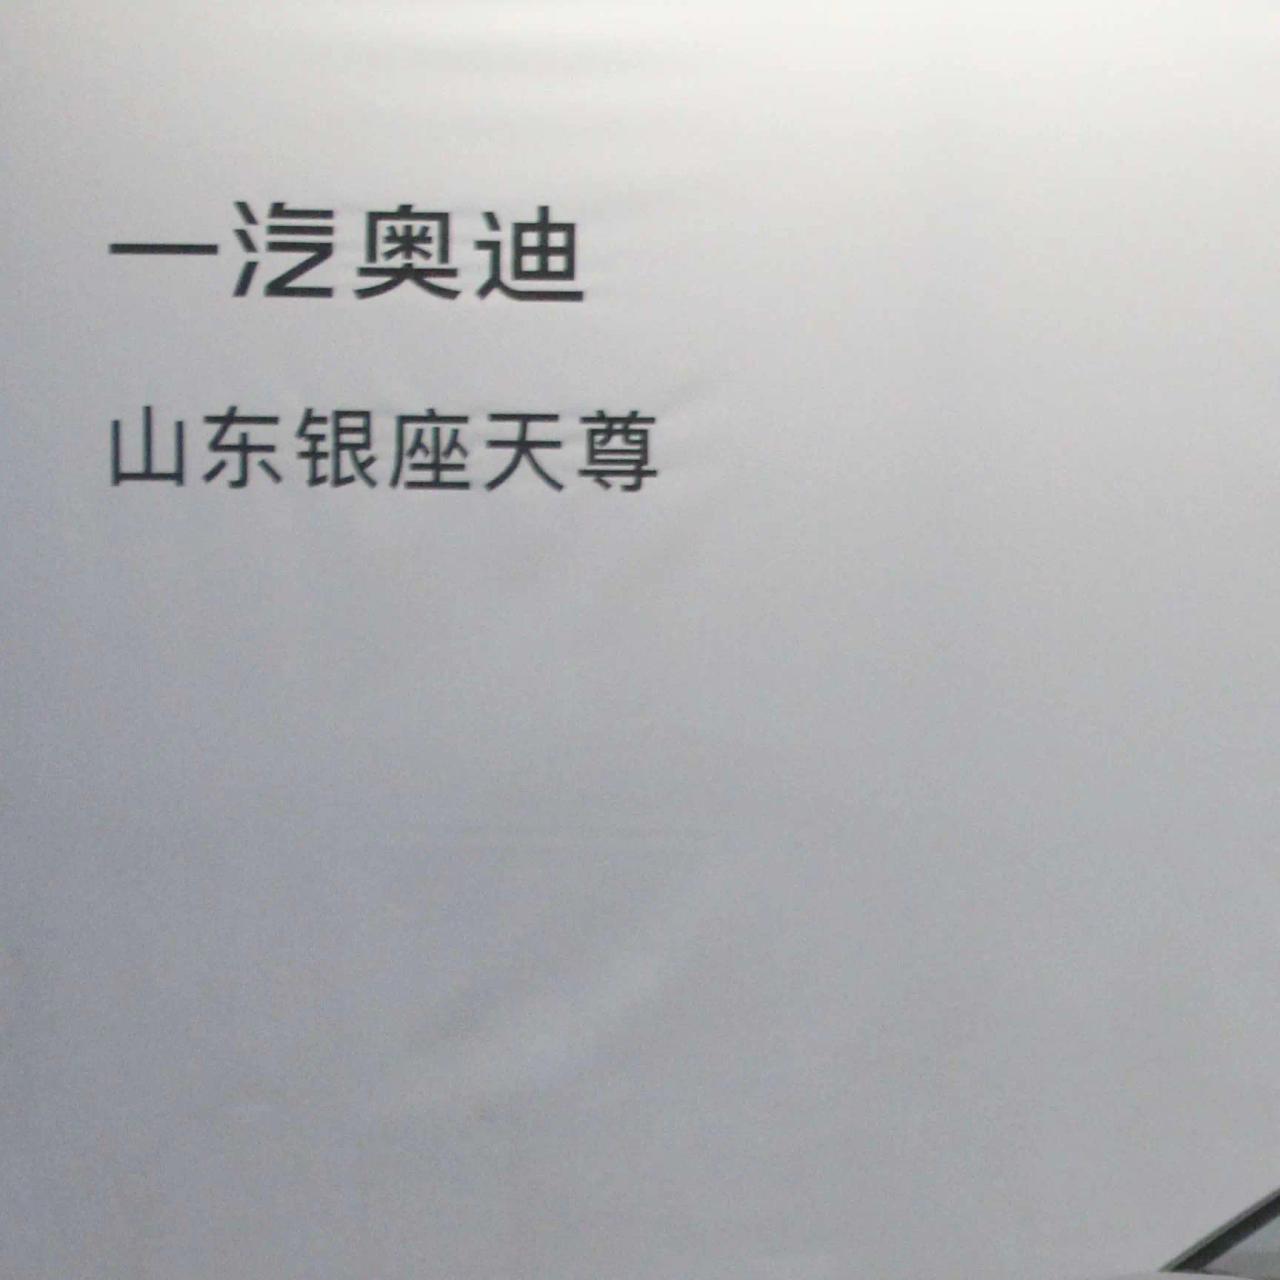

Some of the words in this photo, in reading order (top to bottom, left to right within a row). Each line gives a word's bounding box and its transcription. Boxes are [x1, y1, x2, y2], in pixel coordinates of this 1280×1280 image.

[108, 201, 584, 302] 一汽奥迪
[110, 405, 658, 492] 山东银座天尊
